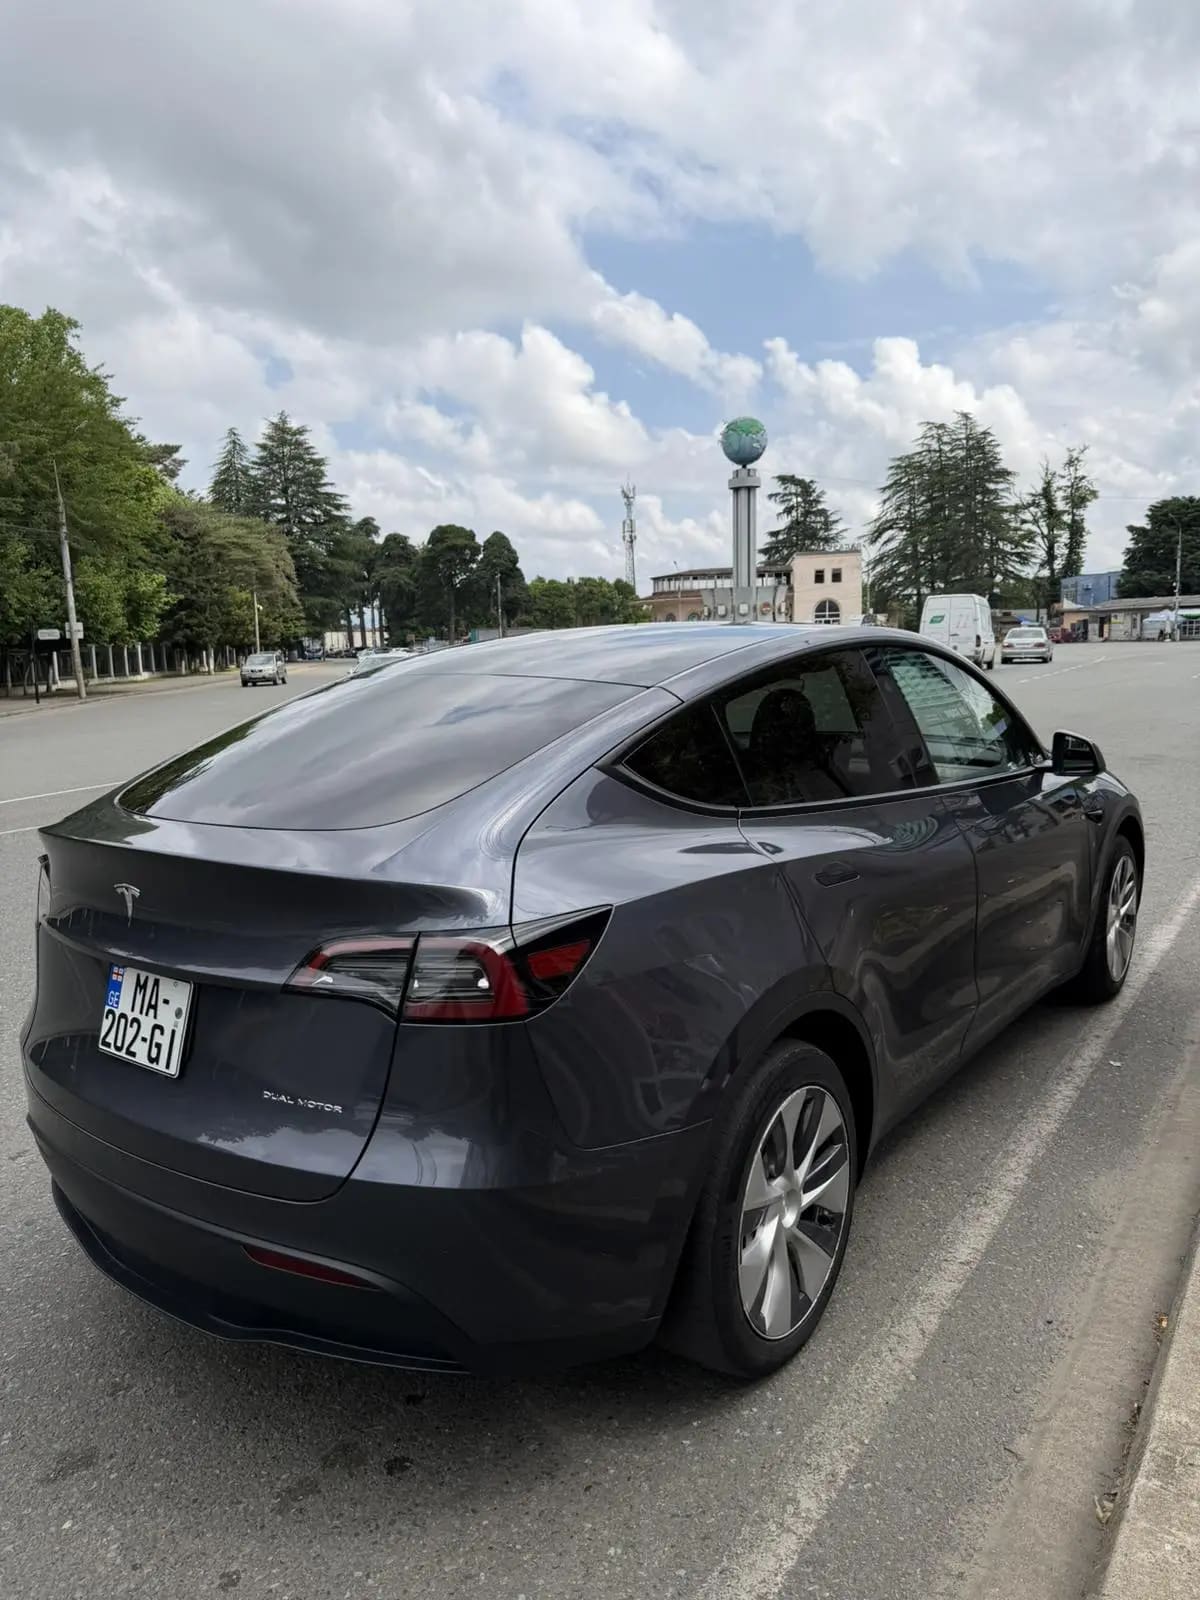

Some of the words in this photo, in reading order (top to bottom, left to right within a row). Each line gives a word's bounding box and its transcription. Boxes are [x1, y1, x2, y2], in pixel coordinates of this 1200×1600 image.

[107, 991, 120, 1008] GE
[131, 973, 170, 1020] MA-
[263, 1090, 295, 1104] DUAL
[297, 1098, 343, 1114] MOTOR
